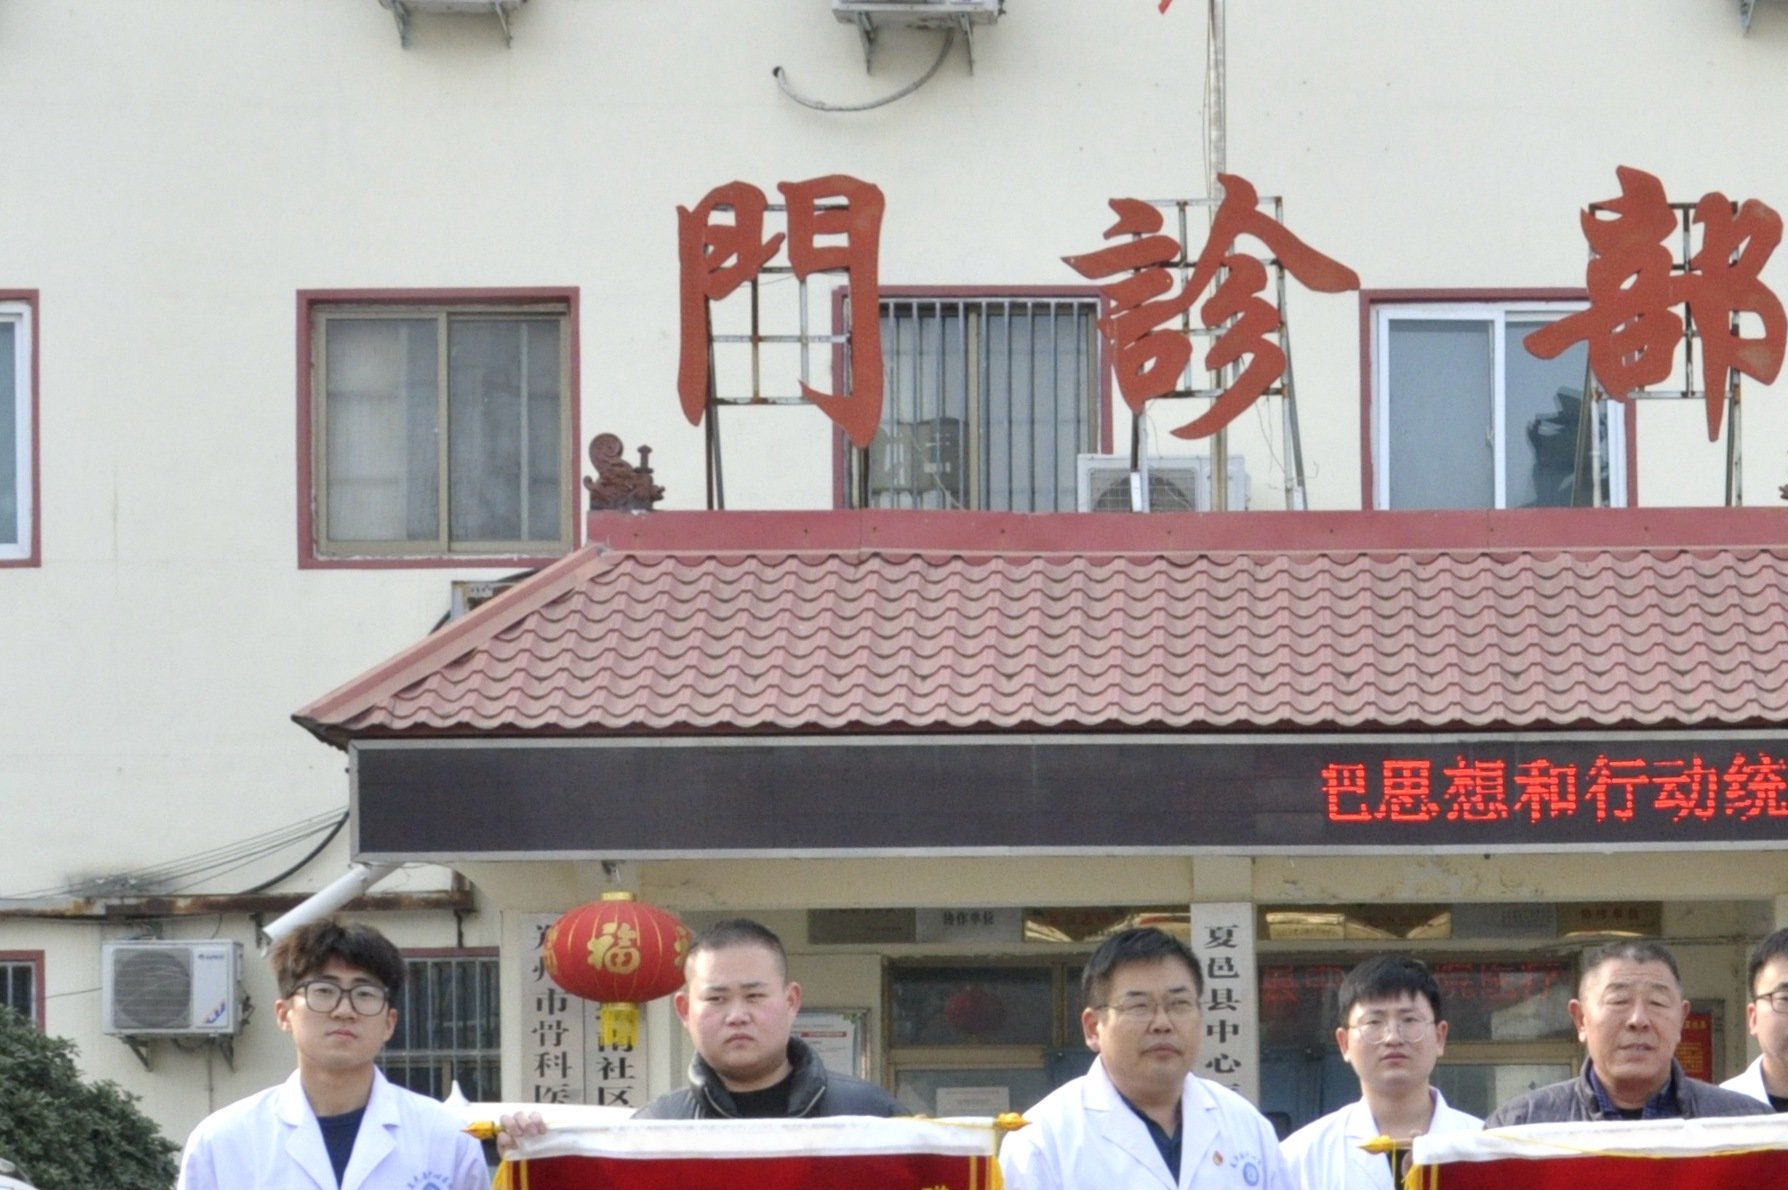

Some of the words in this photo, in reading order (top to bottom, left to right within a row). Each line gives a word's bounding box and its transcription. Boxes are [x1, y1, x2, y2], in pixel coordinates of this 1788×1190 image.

[676, 164, 1788, 449] 門診部
[587, 921, 641, 975] 福
[1202, 924, 1242, 1091] 夏邑县中心
